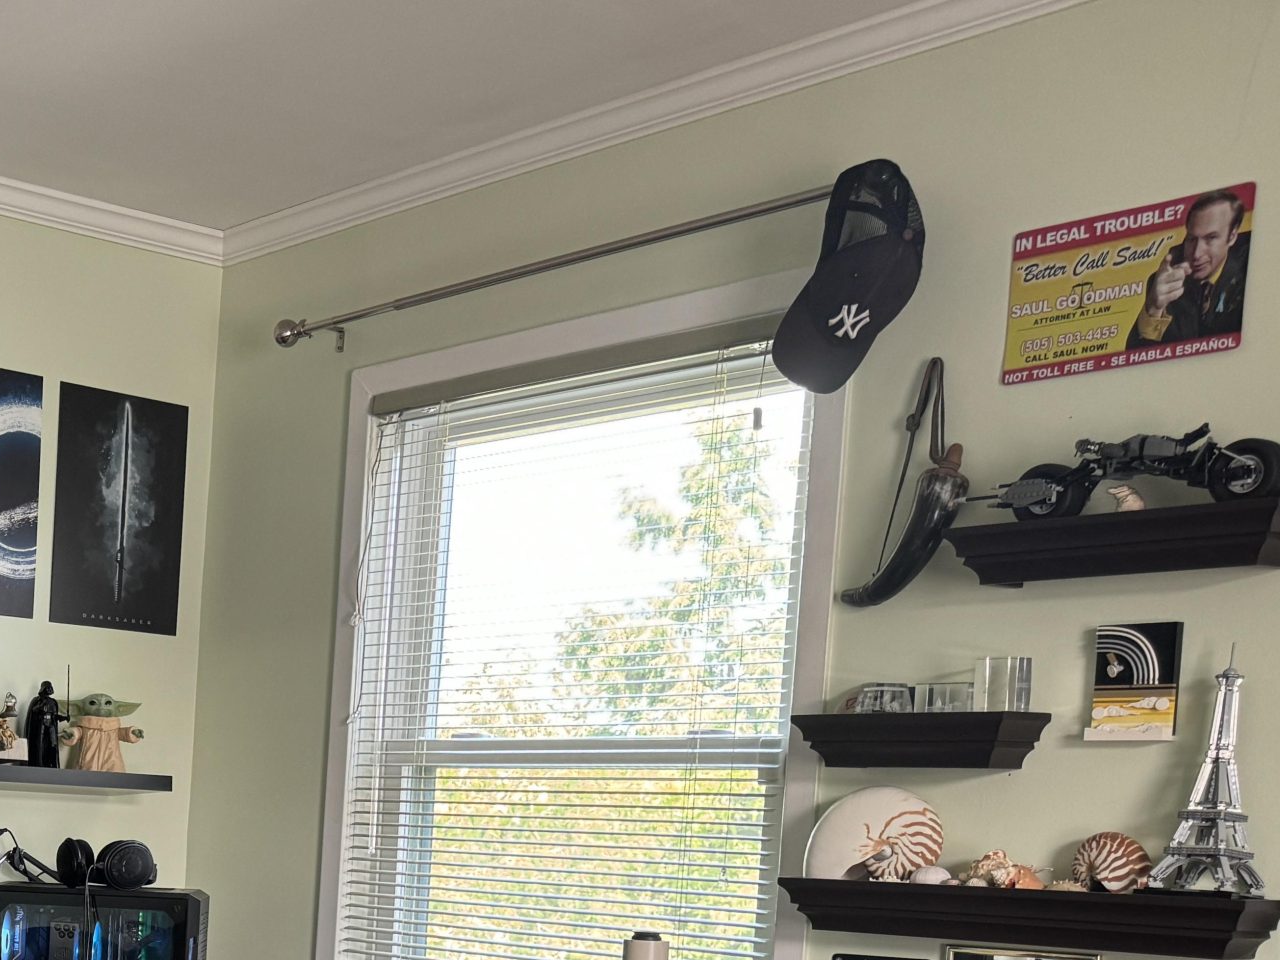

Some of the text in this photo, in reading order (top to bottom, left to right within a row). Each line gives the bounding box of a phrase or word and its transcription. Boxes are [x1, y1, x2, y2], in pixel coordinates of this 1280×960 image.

[1015, 204, 1185, 252] IN LEGAL TROUBLE?
[1072, 250, 1108, 277] Call
[1011, 282, 1143, 318] SAUL GOODMAN
[1033, 312, 1077, 326] ATTORNEY
[1093, 305, 1111, 315] LAW
[1020, 325, 1119, 355] (505) 503-4455
[1024, 342, 1108, 363] CALL SAUL NOW!
[1004, 337, 1236, 384] NOT TOLL FREE SE HABLA ESPAÑOL
